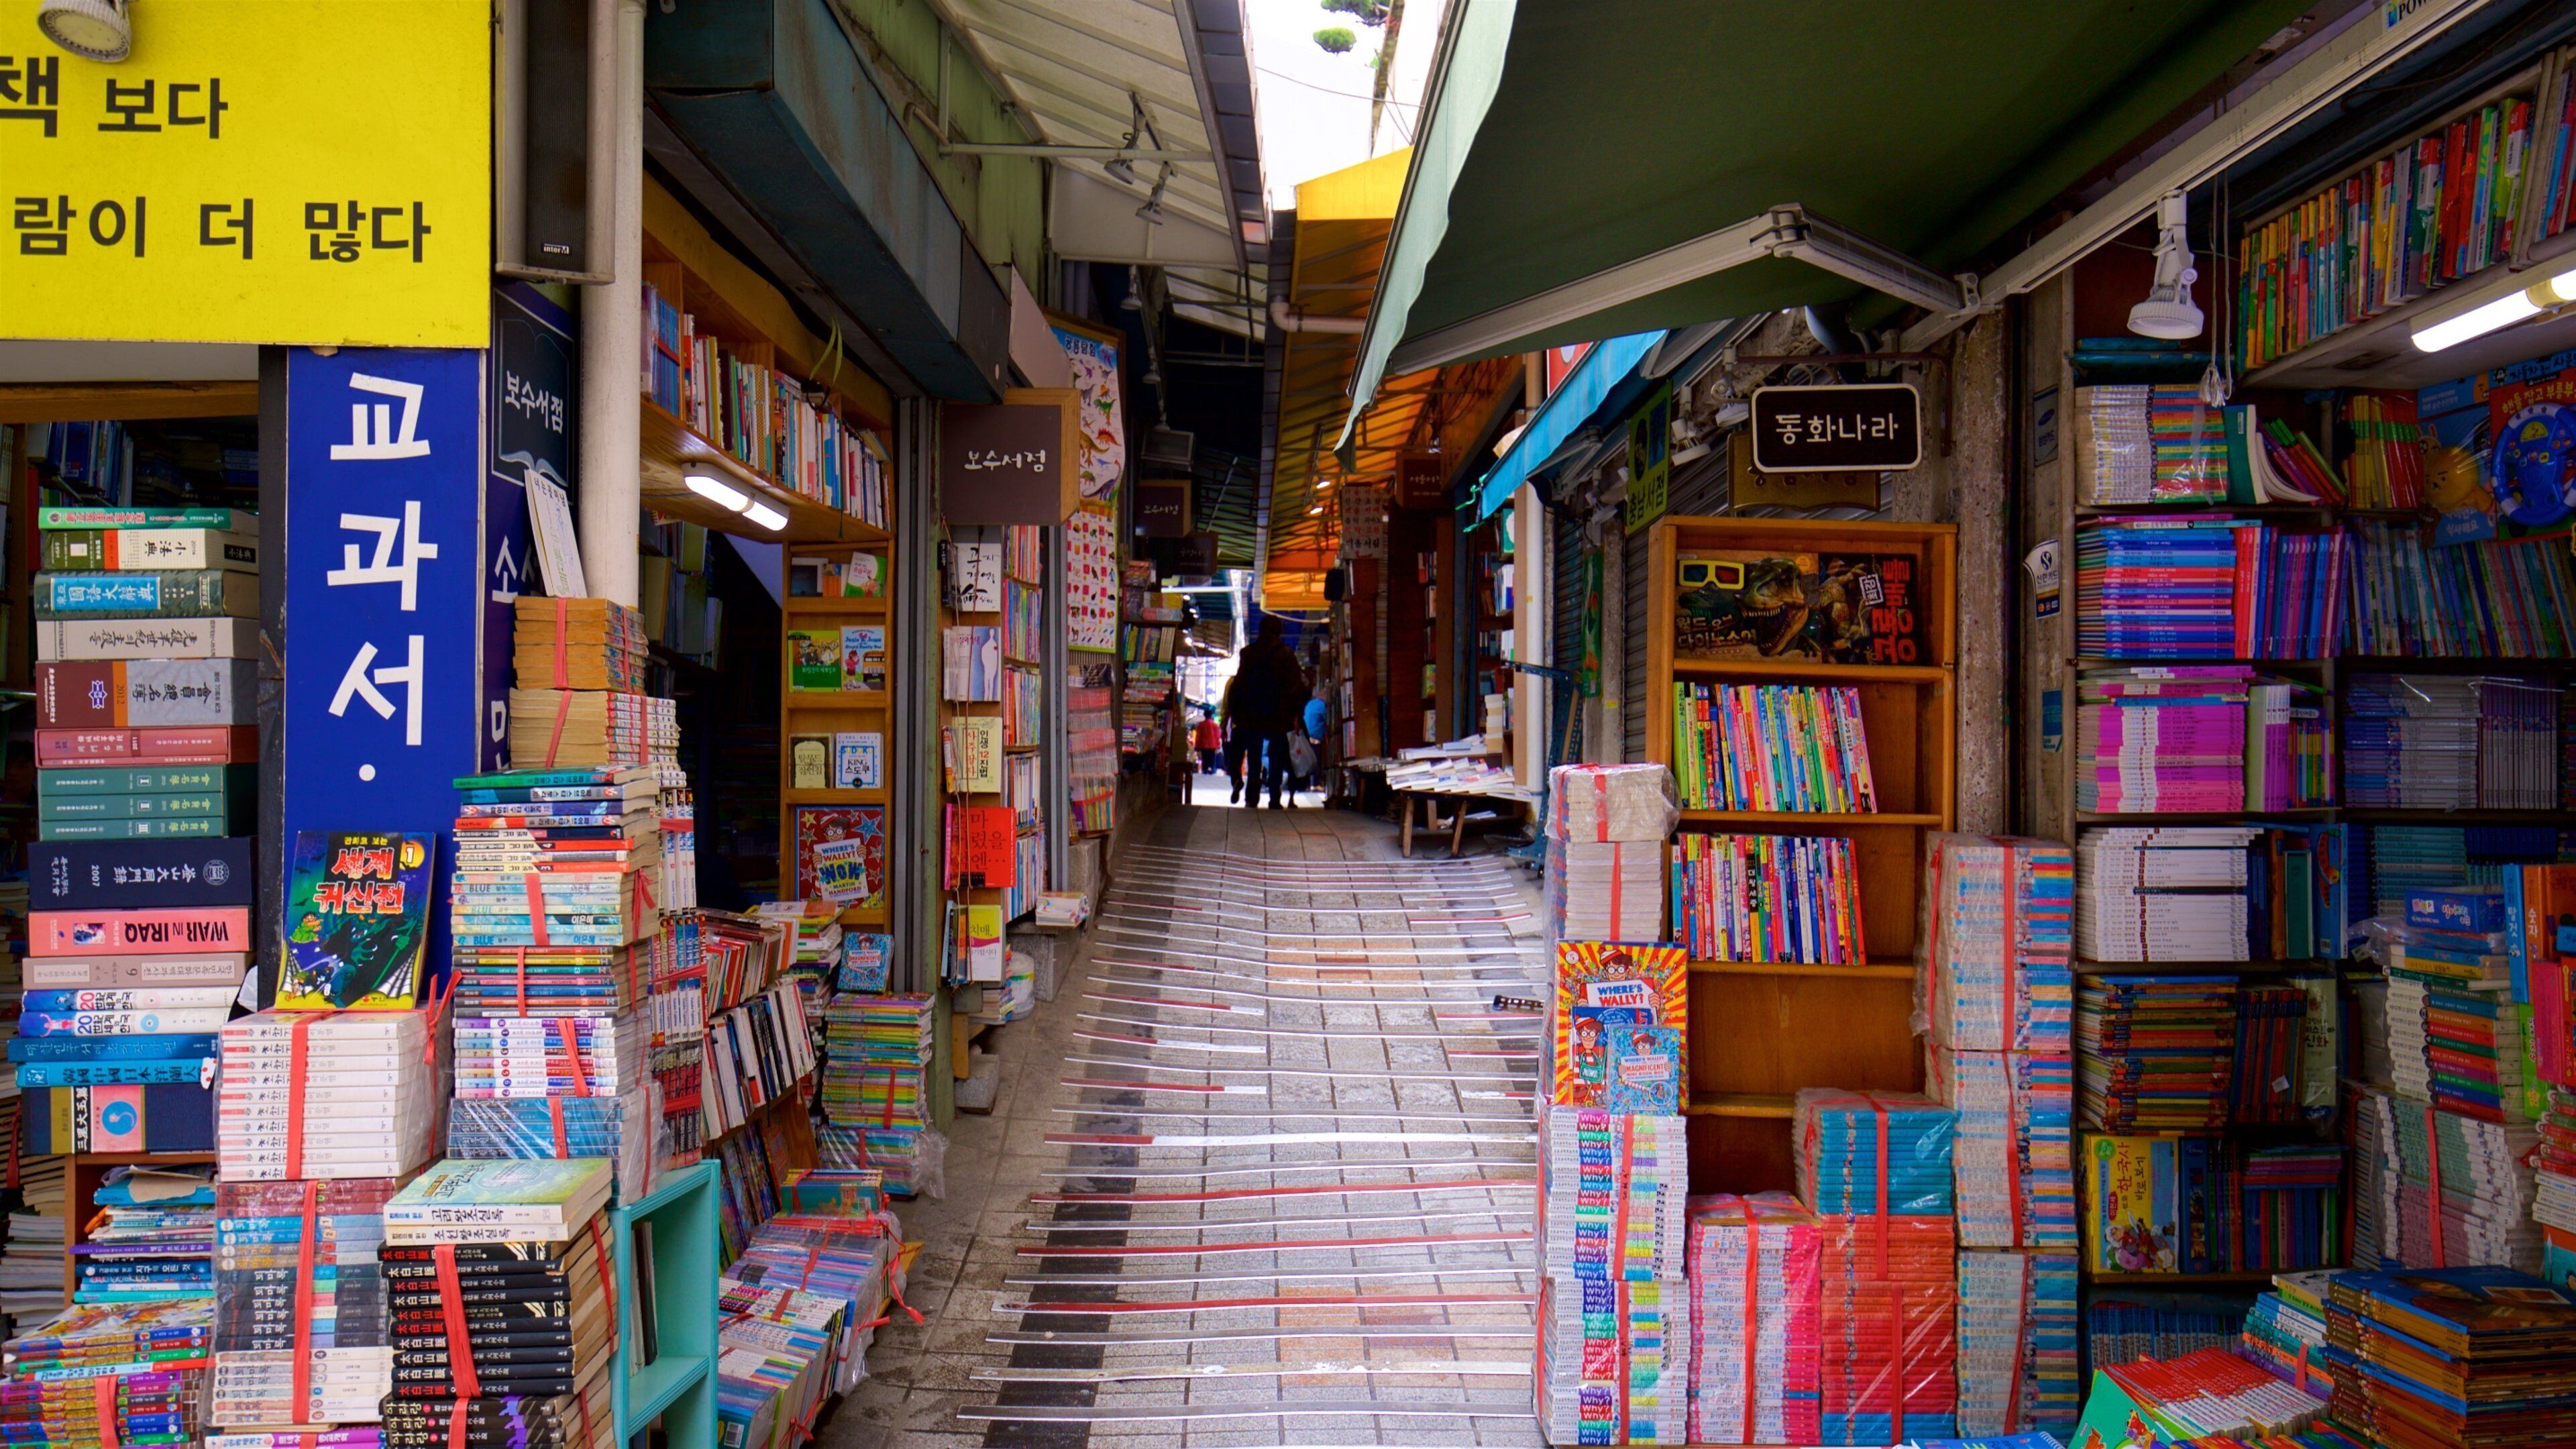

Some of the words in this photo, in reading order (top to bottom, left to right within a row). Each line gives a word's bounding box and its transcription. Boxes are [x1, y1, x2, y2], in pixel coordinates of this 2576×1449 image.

[0, 56, 58, 138] 책
[97, 78, 228, 140] 보다
[13, 195, 146, 258] 람이
[200, 198, 254, 260] 더
[304, 200, 431, 263] 많다
[1776, 413, 1898, 445] 동화나라
[965, 449, 1046, 472] 보수서점
[1144, 505, 1179, 515] 보수서점
[1629, 480, 1666, 525] 충남서점
[146, 540, 186, 557] 小法典
[327, 372, 438, 745] 교과서
[1882, 557, 1911, 606] 배틀
[2036, 572, 2058, 585] 신한카드
[1864, 579, 1878, 600] 최강
[1676, 616, 1708, 630] 월드
[1677, 629, 1757, 649] 다이노소어
[1872, 606, 1917, 664] 공룡
[116, 685, 125, 704] 2012
[980, 730, 989, 749] 인생
[845, 766, 871, 774] 스도쿠
[979, 759, 989, 778] 진법
[406, 847, 415, 864] 1
[821, 844, 855, 854] WHERE'S
[822, 851, 856, 862] WALLY?
[331, 847, 394, 879] 세계
[91, 865, 100, 887] 2007
[818, 861, 863, 885] WOW
[313, 881, 405, 914] 귀신전
[828, 886, 862, 896] HANDFORD
[172, 922, 184, 936] IN
[2528, 907, 2538, 938] 숫자
[125, 922, 169, 942] IRAQ
[186, 922, 229, 941] WAR
[474, 936, 494, 945] BLUE
[1570, 953, 1576, 961] 5
[1597, 983, 1644, 996] WHERE'S
[80, 992, 95, 1010] 20
[1598, 994, 1644, 1006] WALLY?
[78, 1015, 92, 1034] 20
[120, 1014, 131, 1033] 한국
[63, 1067, 203, 1084] 韓國中國日本洋蘭大
[1580, 1114, 1607, 1123] Why?
[1582, 1148, 1609, 1156] Why?
[1583, 1157, 1609, 1165] Why?
[2117, 1142, 2132, 1193] 한국사
[1583, 1166, 1609, 1174] Why?
[434, 1228, 512, 1240] 조선왕조실록
[1579, 1230, 1605, 1238] Why?
[1577, 1246, 1603, 1254] Why?
[1578, 1270, 1604, 1278] Why?
[387, 1403, 422, 1415] 아리랑
[390, 1417, 426, 1429] 아리랑
[393, 1432, 429, 1444] 아리랑
